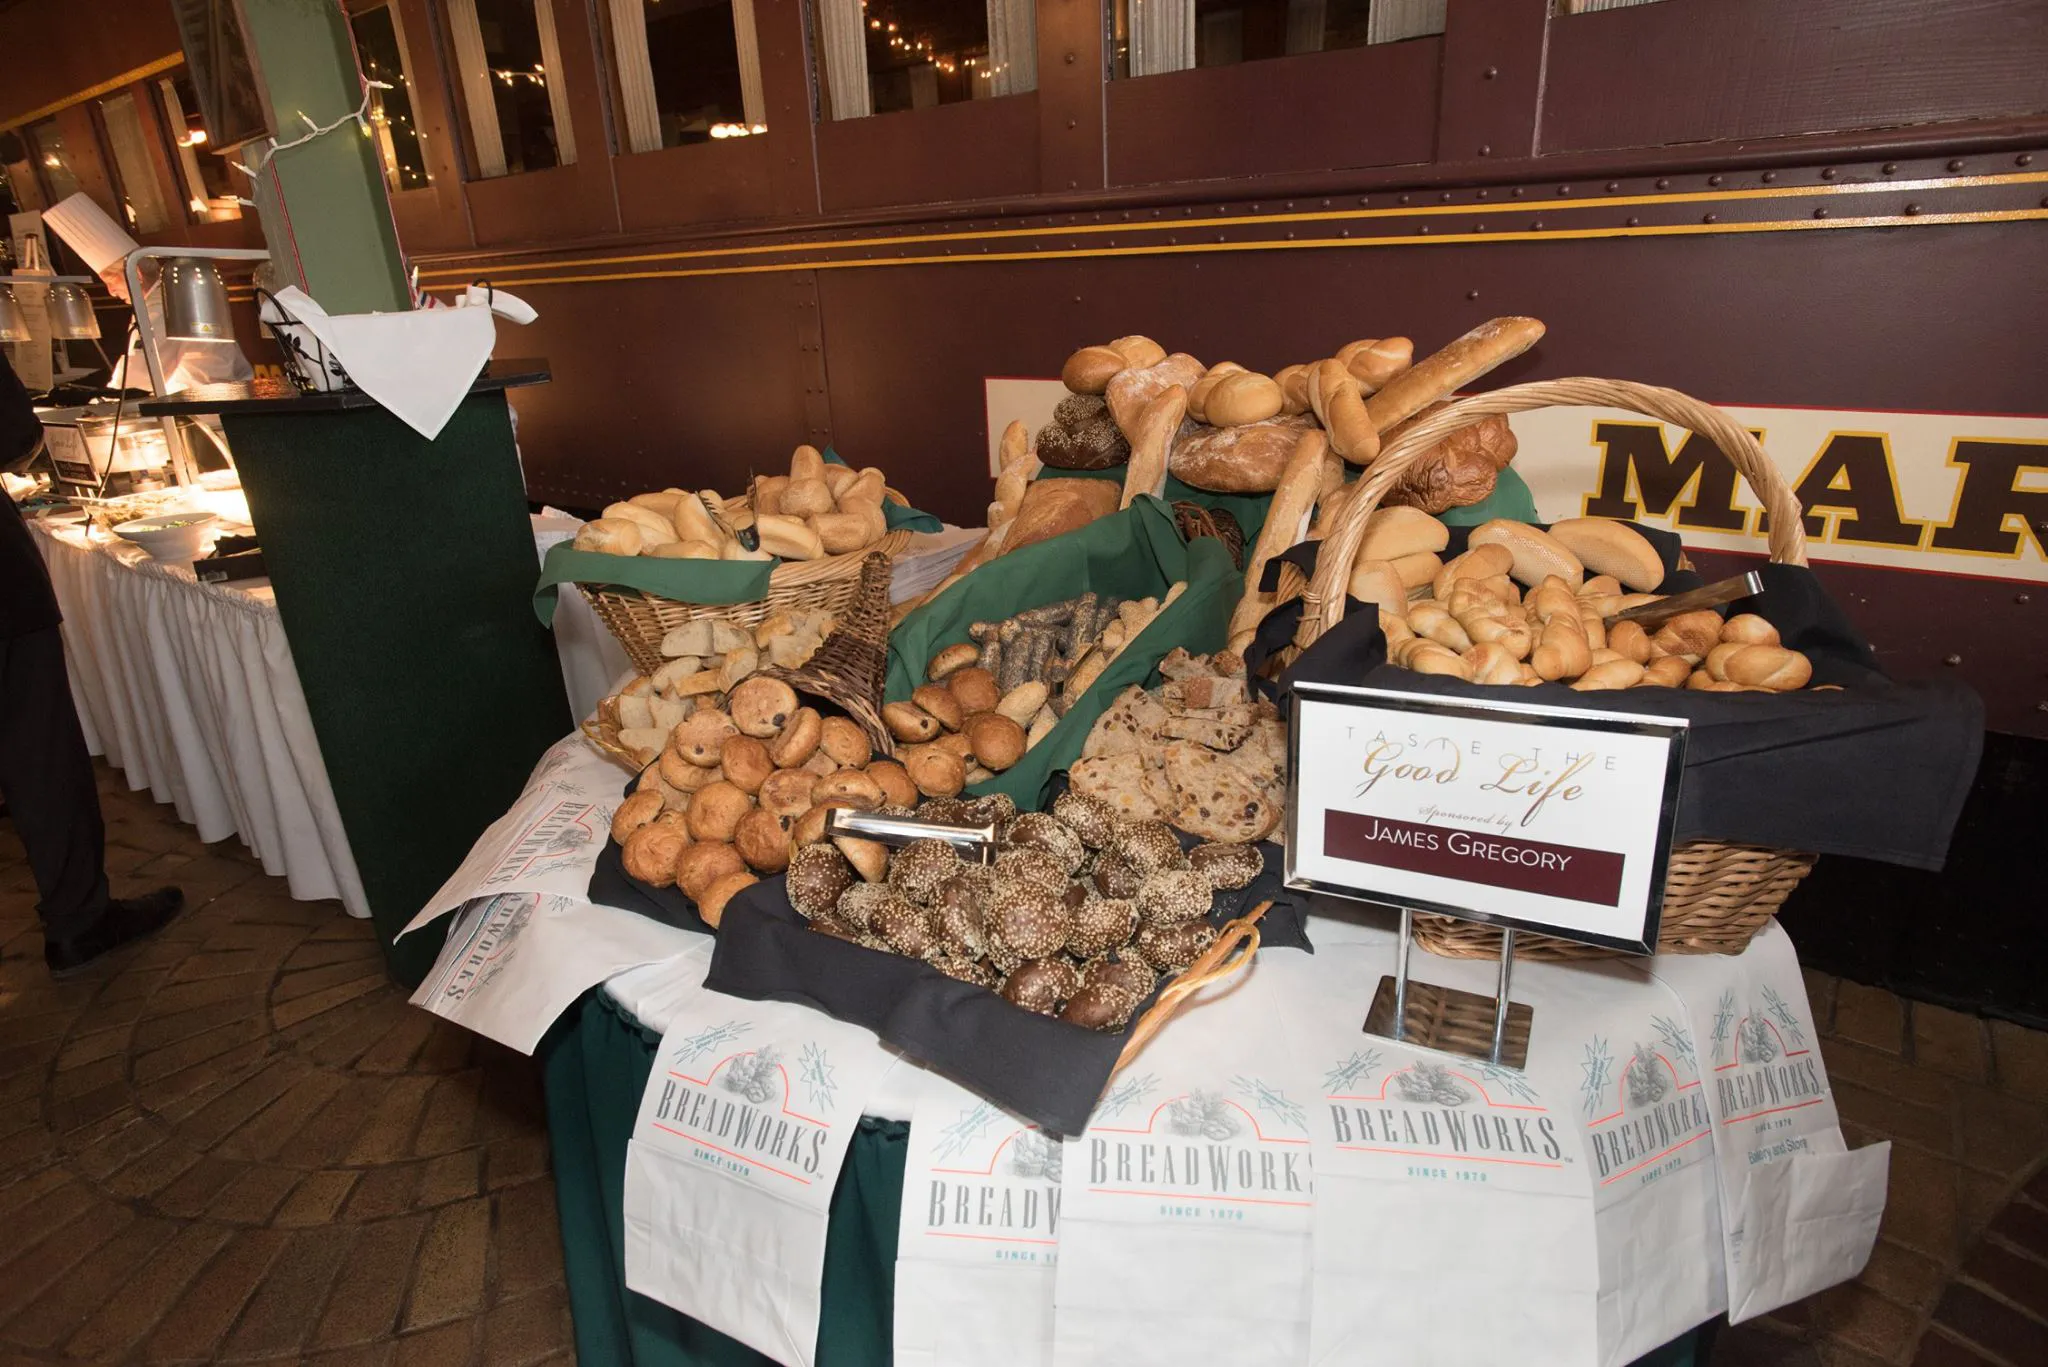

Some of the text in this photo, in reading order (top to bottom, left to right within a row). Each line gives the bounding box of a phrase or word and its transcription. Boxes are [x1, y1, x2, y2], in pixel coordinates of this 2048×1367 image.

[1345, 726, 1617, 771] TASTE THE
[1355, 737, 1597, 828] Good Life
[1418, 804, 1513, 835] Sponsored by
[1364, 819, 1573, 872] JAMES GREGORY
[1592, 1091, 1710, 1178] BREADWORK
[694, 1147, 723, 1167] SINCE
[1089, 1137, 1313, 1195] BREADWORK
[1408, 1166, 1448, 1179] SINCE
[1160, 1204, 1201, 1218] SINCE
[995, 1249, 1036, 1261] SINCE
